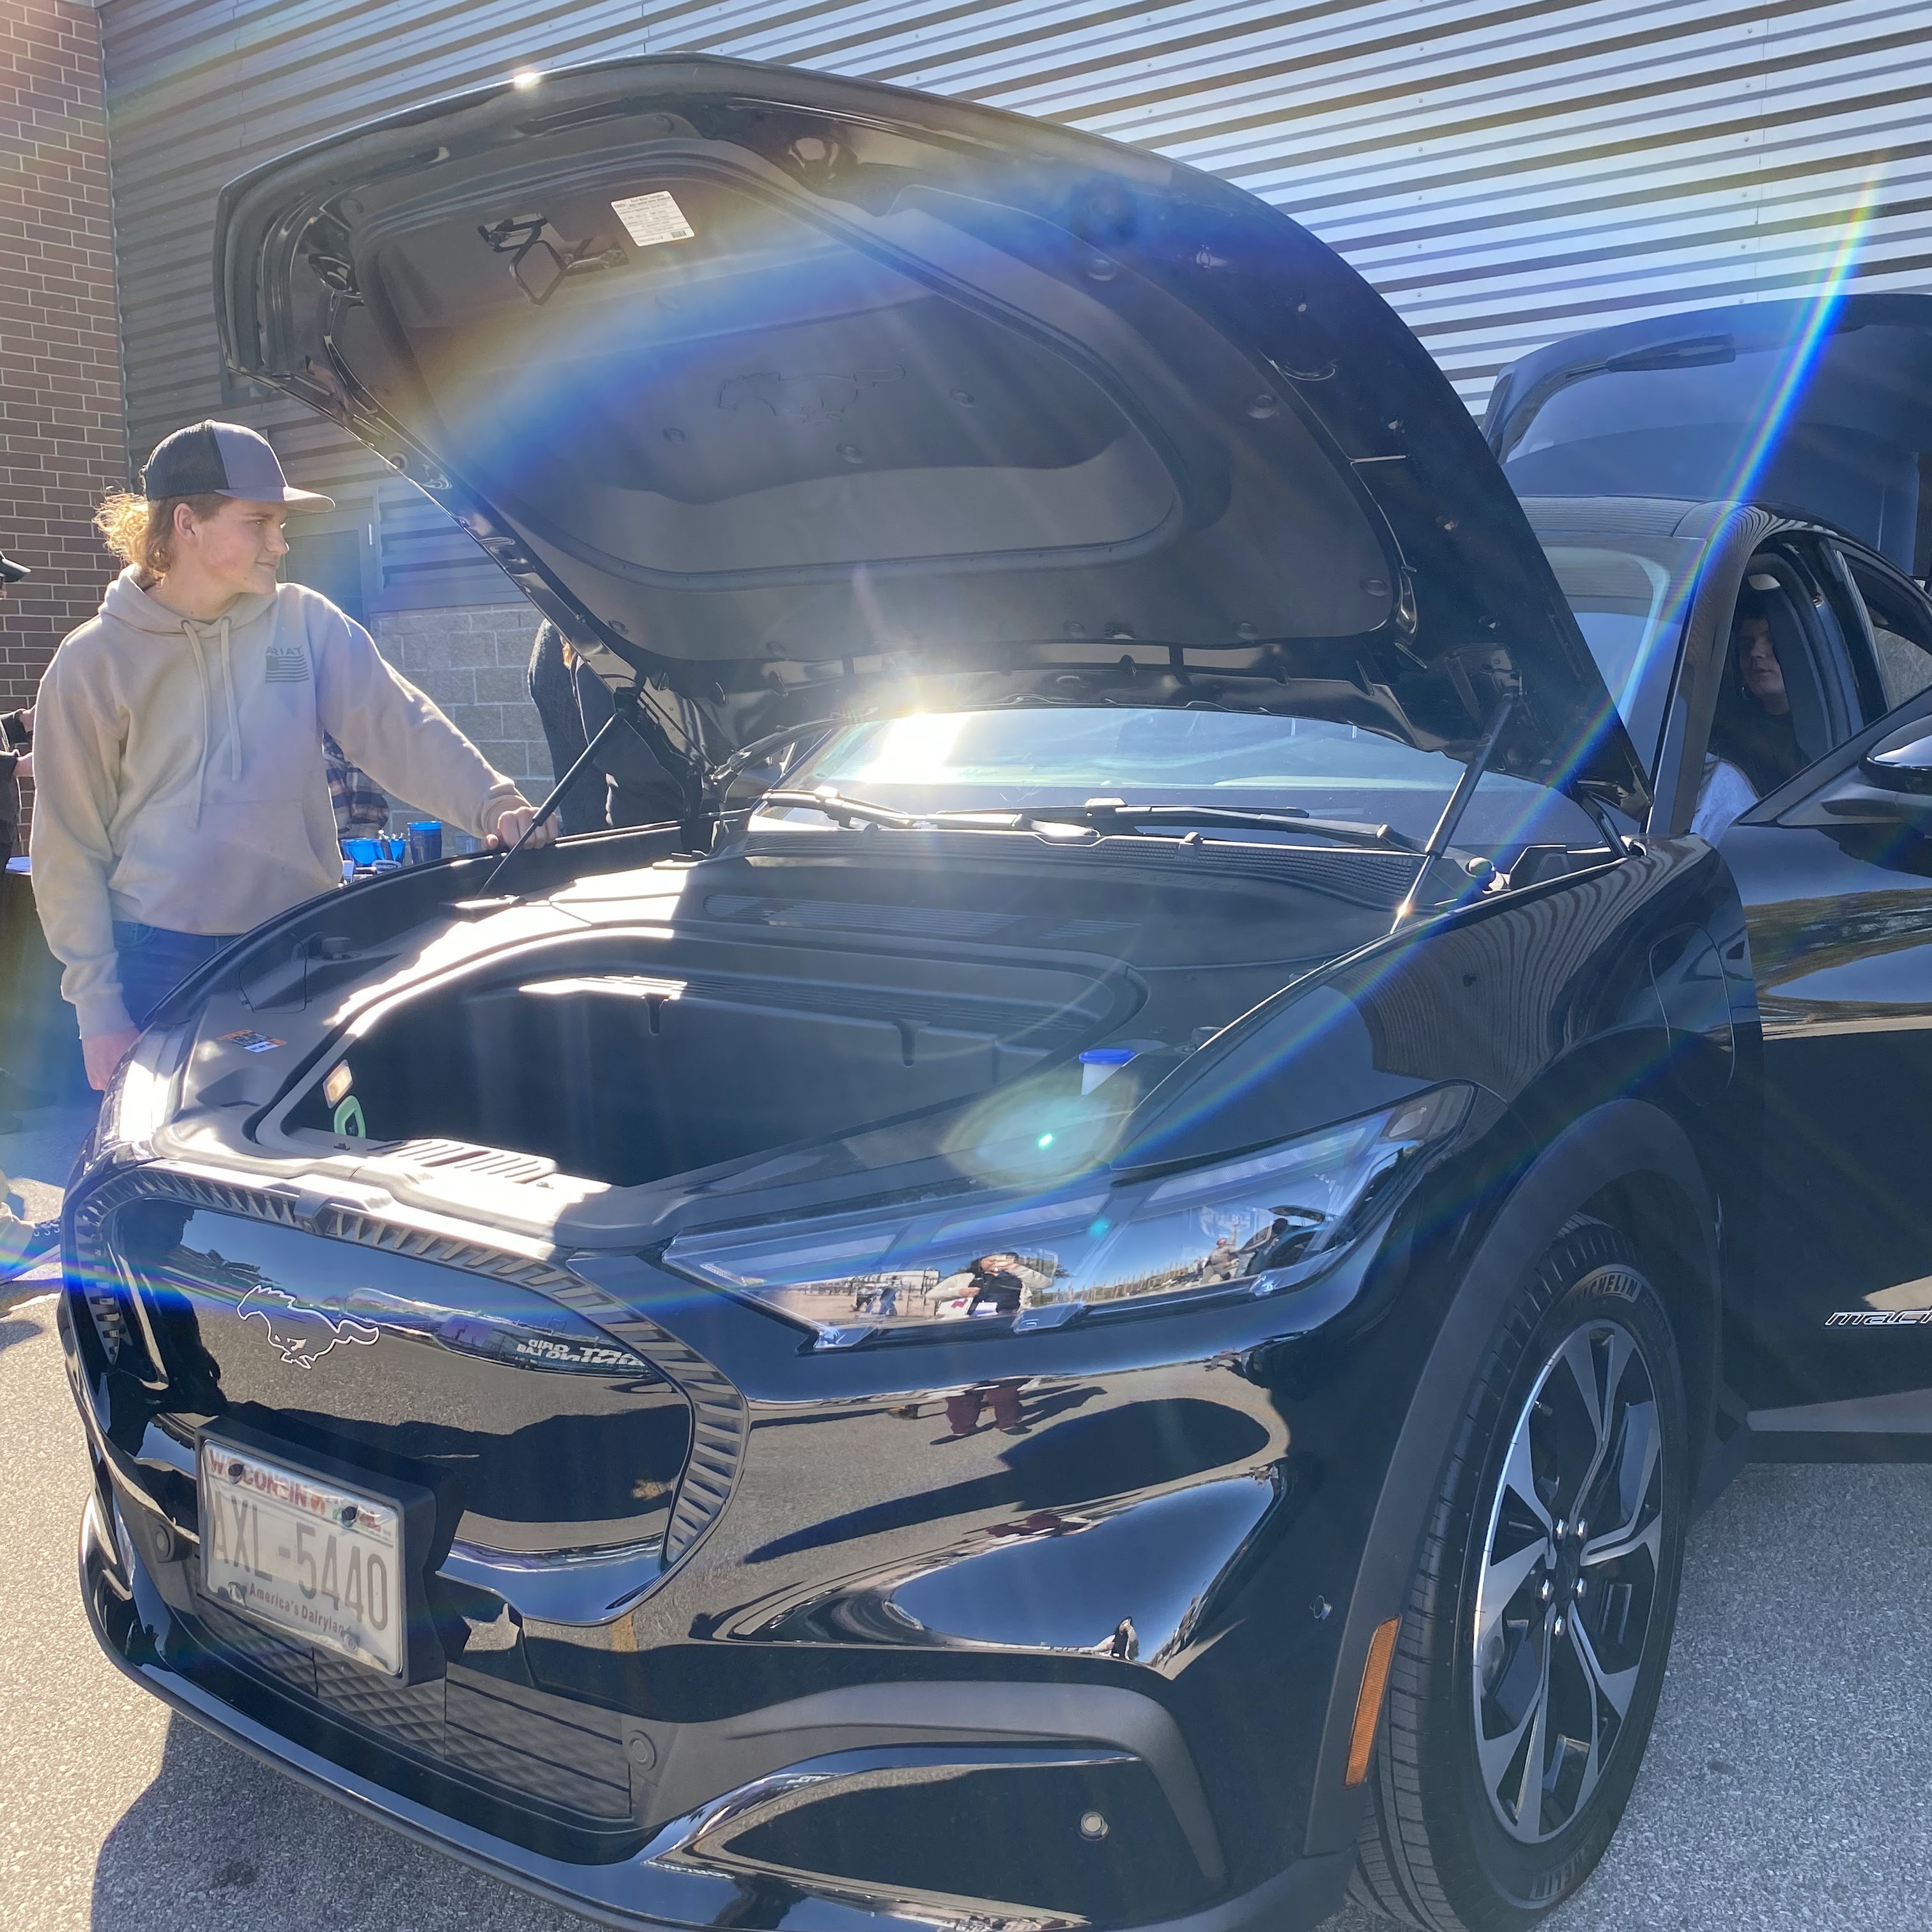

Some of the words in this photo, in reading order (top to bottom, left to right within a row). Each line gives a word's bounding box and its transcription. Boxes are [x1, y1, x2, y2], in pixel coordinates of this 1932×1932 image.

[265, 645, 302, 656] ARIAT
[210, 1448, 307, 1508] WICONSIN
[213, 1491, 388, 1631] AXL-5440
[250, 1583, 300, 1616] America's
